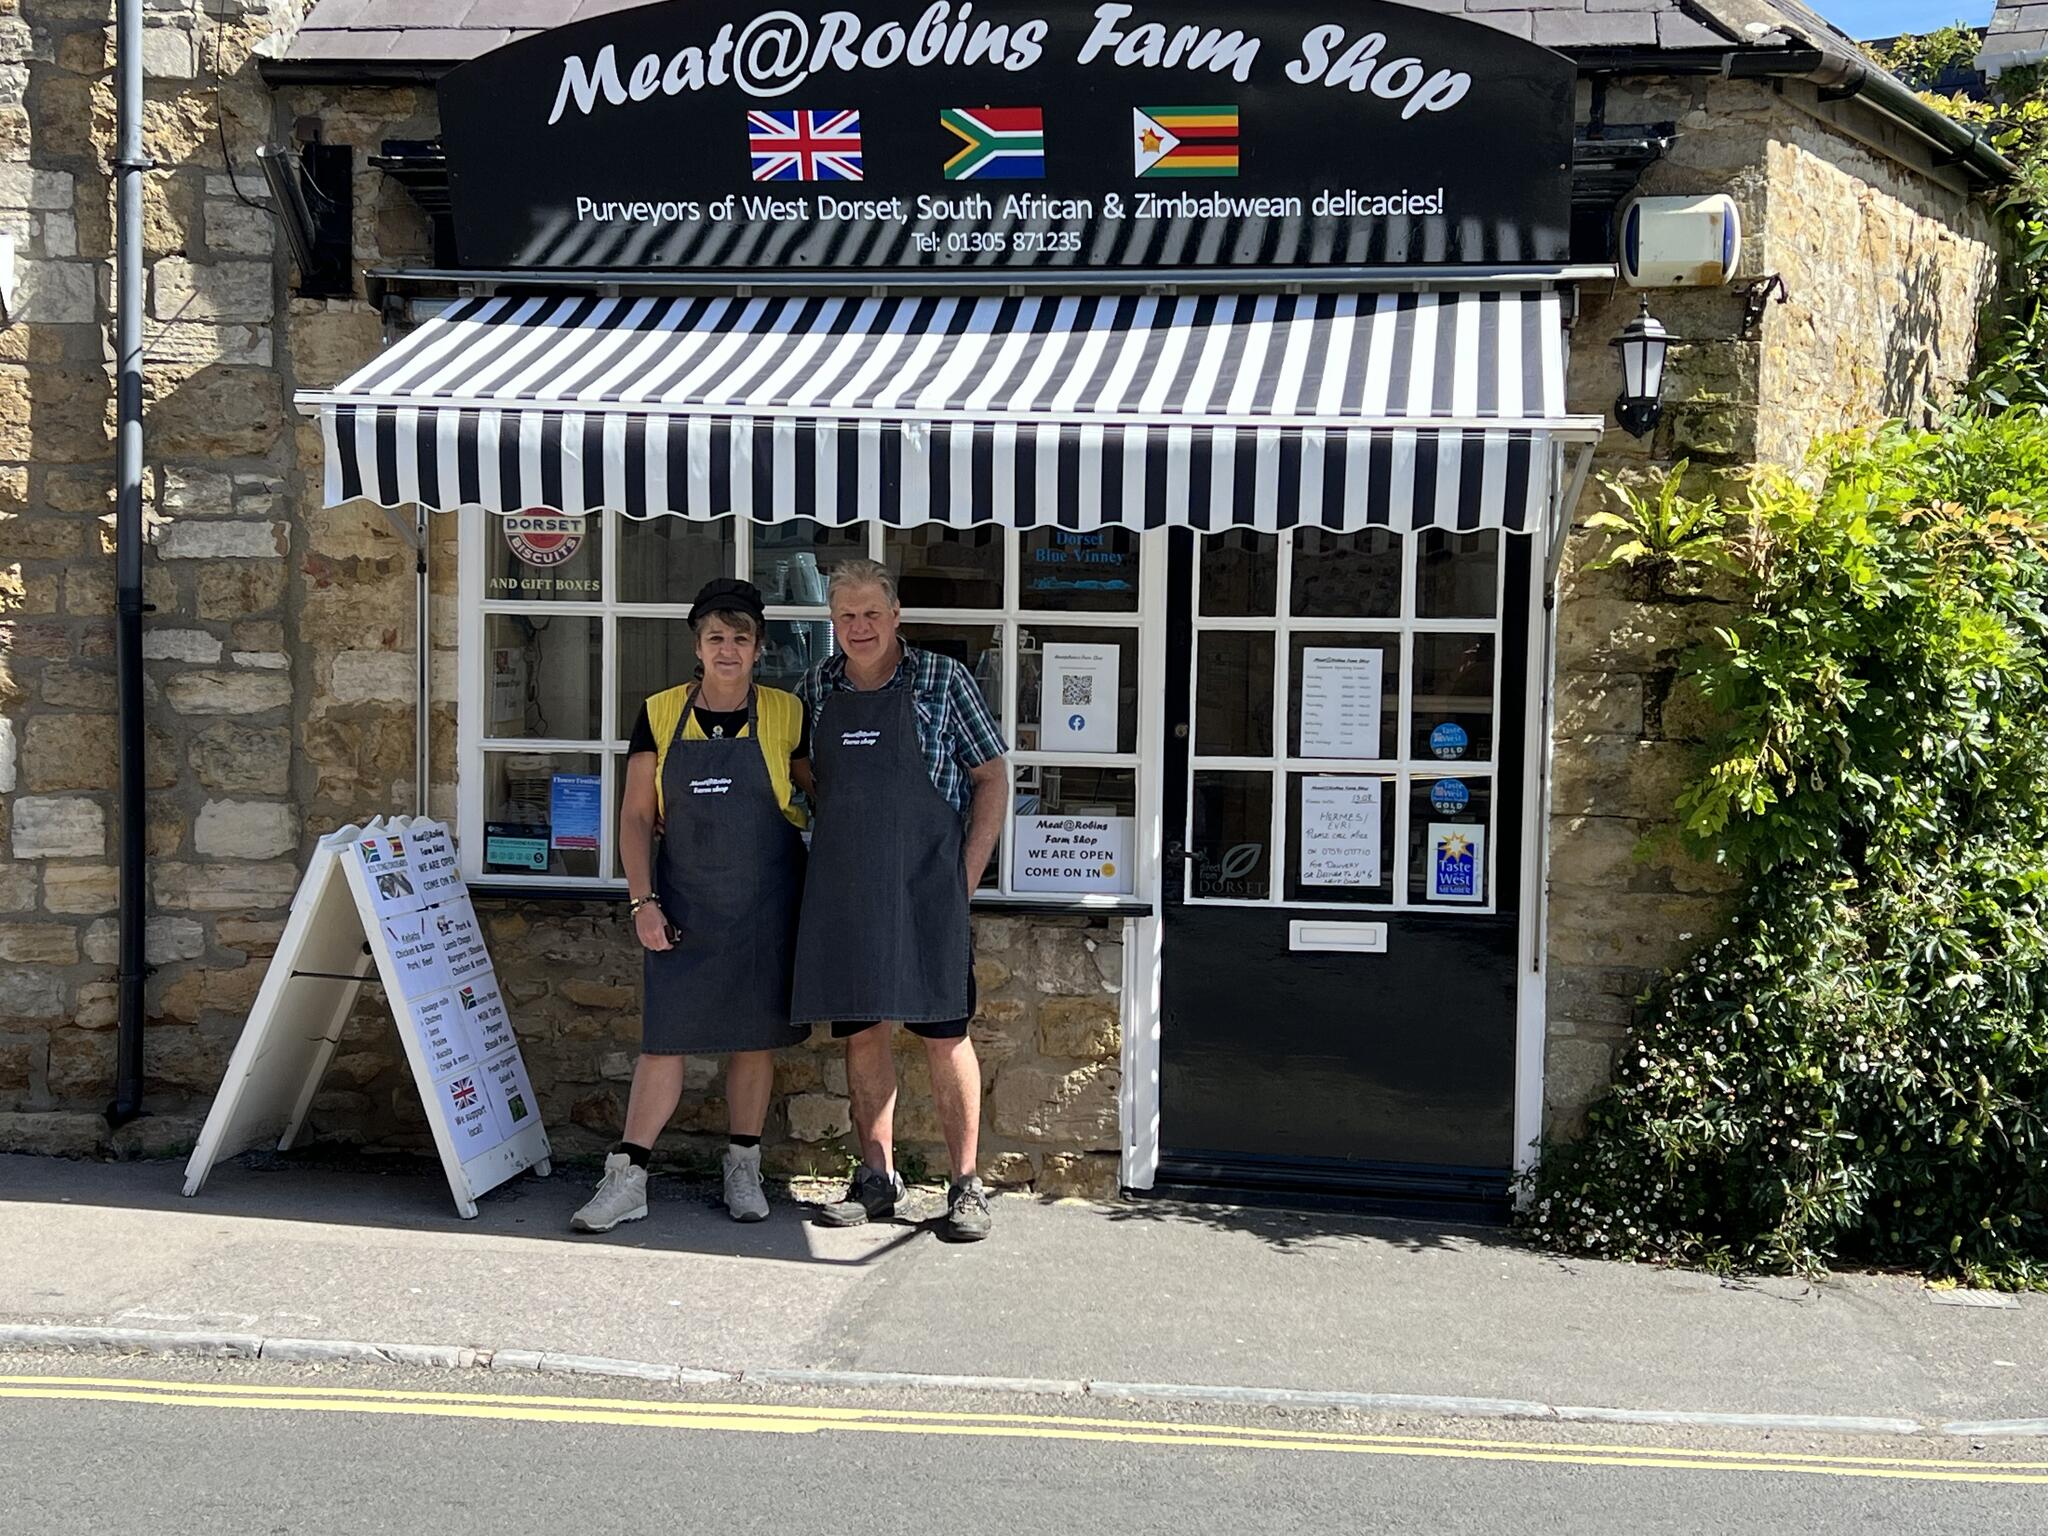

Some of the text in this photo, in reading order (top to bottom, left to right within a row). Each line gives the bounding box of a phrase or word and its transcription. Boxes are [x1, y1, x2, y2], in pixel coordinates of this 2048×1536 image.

[548, 0, 1471, 125] Meat@Robins Farm Shop
[577, 188, 1444, 226] Purveyors of West Dorset, South African & Zimbabwean delicacies!
[911, 231, 1081, 252] Tel: 01305 871235
[506, 518, 582, 531] DORSET
[511, 537, 577, 563] BISCUITS
[1035, 548, 1125, 566] Blue Vinney
[489, 577, 600, 591] AND GIFT BOXES
[1036, 819, 1108, 832] Meat@Robins
[1045, 834, 1098, 846] Farm Shop
[1028, 849, 1113, 860] WE ARE OPEN
[1025, 867, 1101, 878] COME ON IN
[1439, 860, 1471, 873] Taste
[1440, 873, 1470, 886] West
[1200, 880, 1265, 894] DORSET
